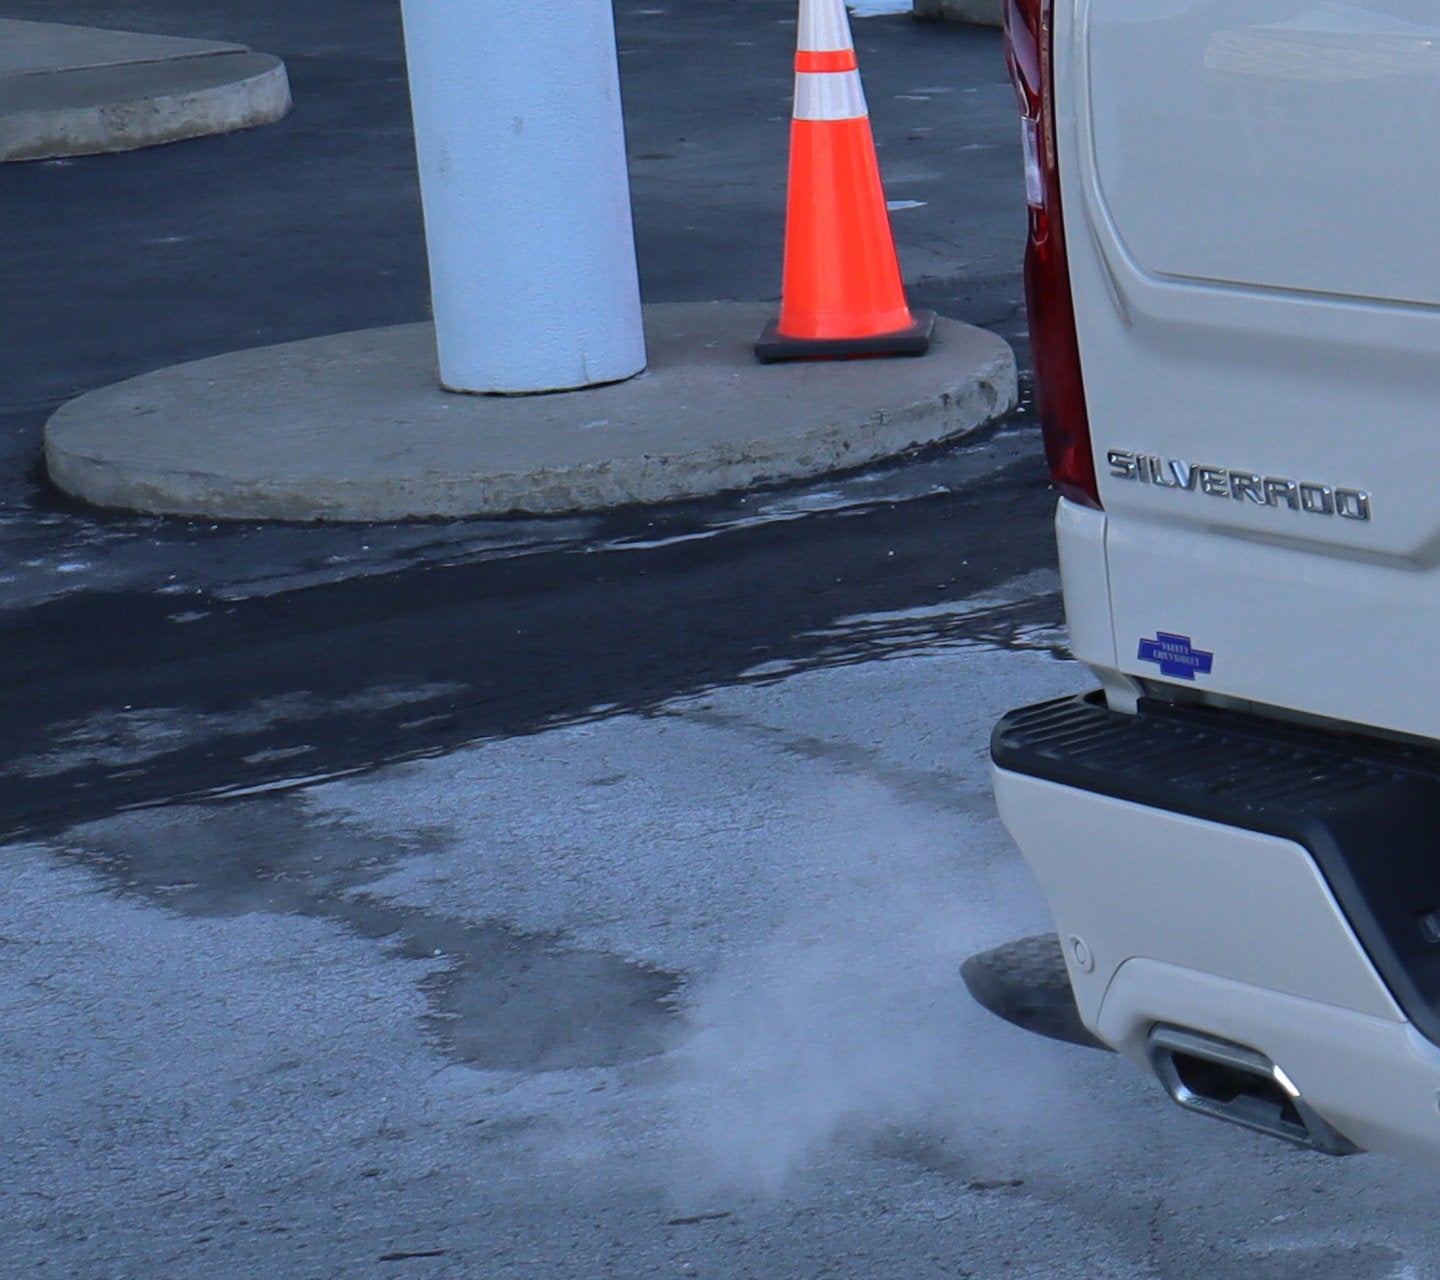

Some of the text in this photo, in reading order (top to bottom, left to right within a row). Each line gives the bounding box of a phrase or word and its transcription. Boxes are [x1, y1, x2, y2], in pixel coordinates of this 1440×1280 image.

[1107, 448, 1371, 521] SILVERADO
[1161, 641, 1189, 655] VALLEY
[1153, 649, 1200, 667] CHEVROLET
